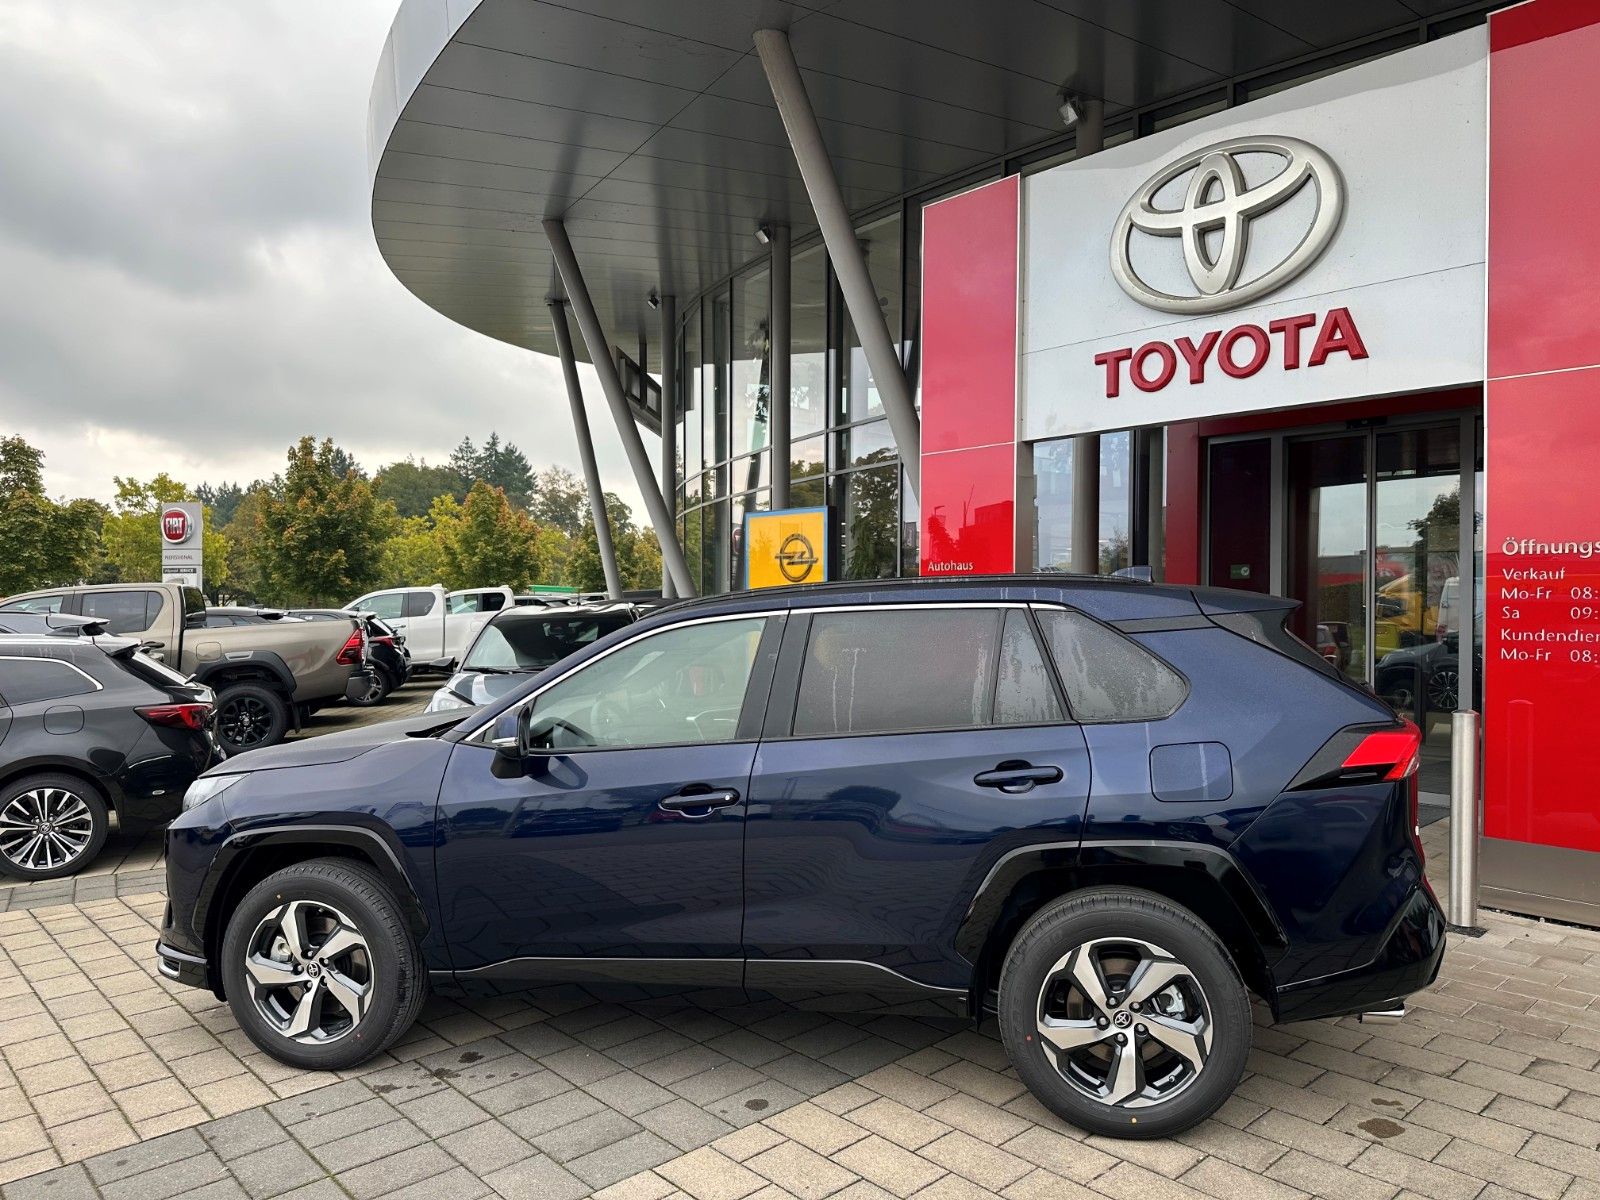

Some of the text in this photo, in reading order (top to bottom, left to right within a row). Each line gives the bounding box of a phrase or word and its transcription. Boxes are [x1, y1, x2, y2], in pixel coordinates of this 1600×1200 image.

[1095, 307, 1369, 398] TOYOTA
[165, 517, 184, 534] FIAT
[928, 560, 974, 571] Autohaus
[1502, 567, 1565, 580] Verkauf
[1501, 587, 1599, 600] Mo-Fr 08:
[1502, 606, 1599, 620] Sa 09:
[1501, 648, 1599, 663] Mo-Fr 08:
